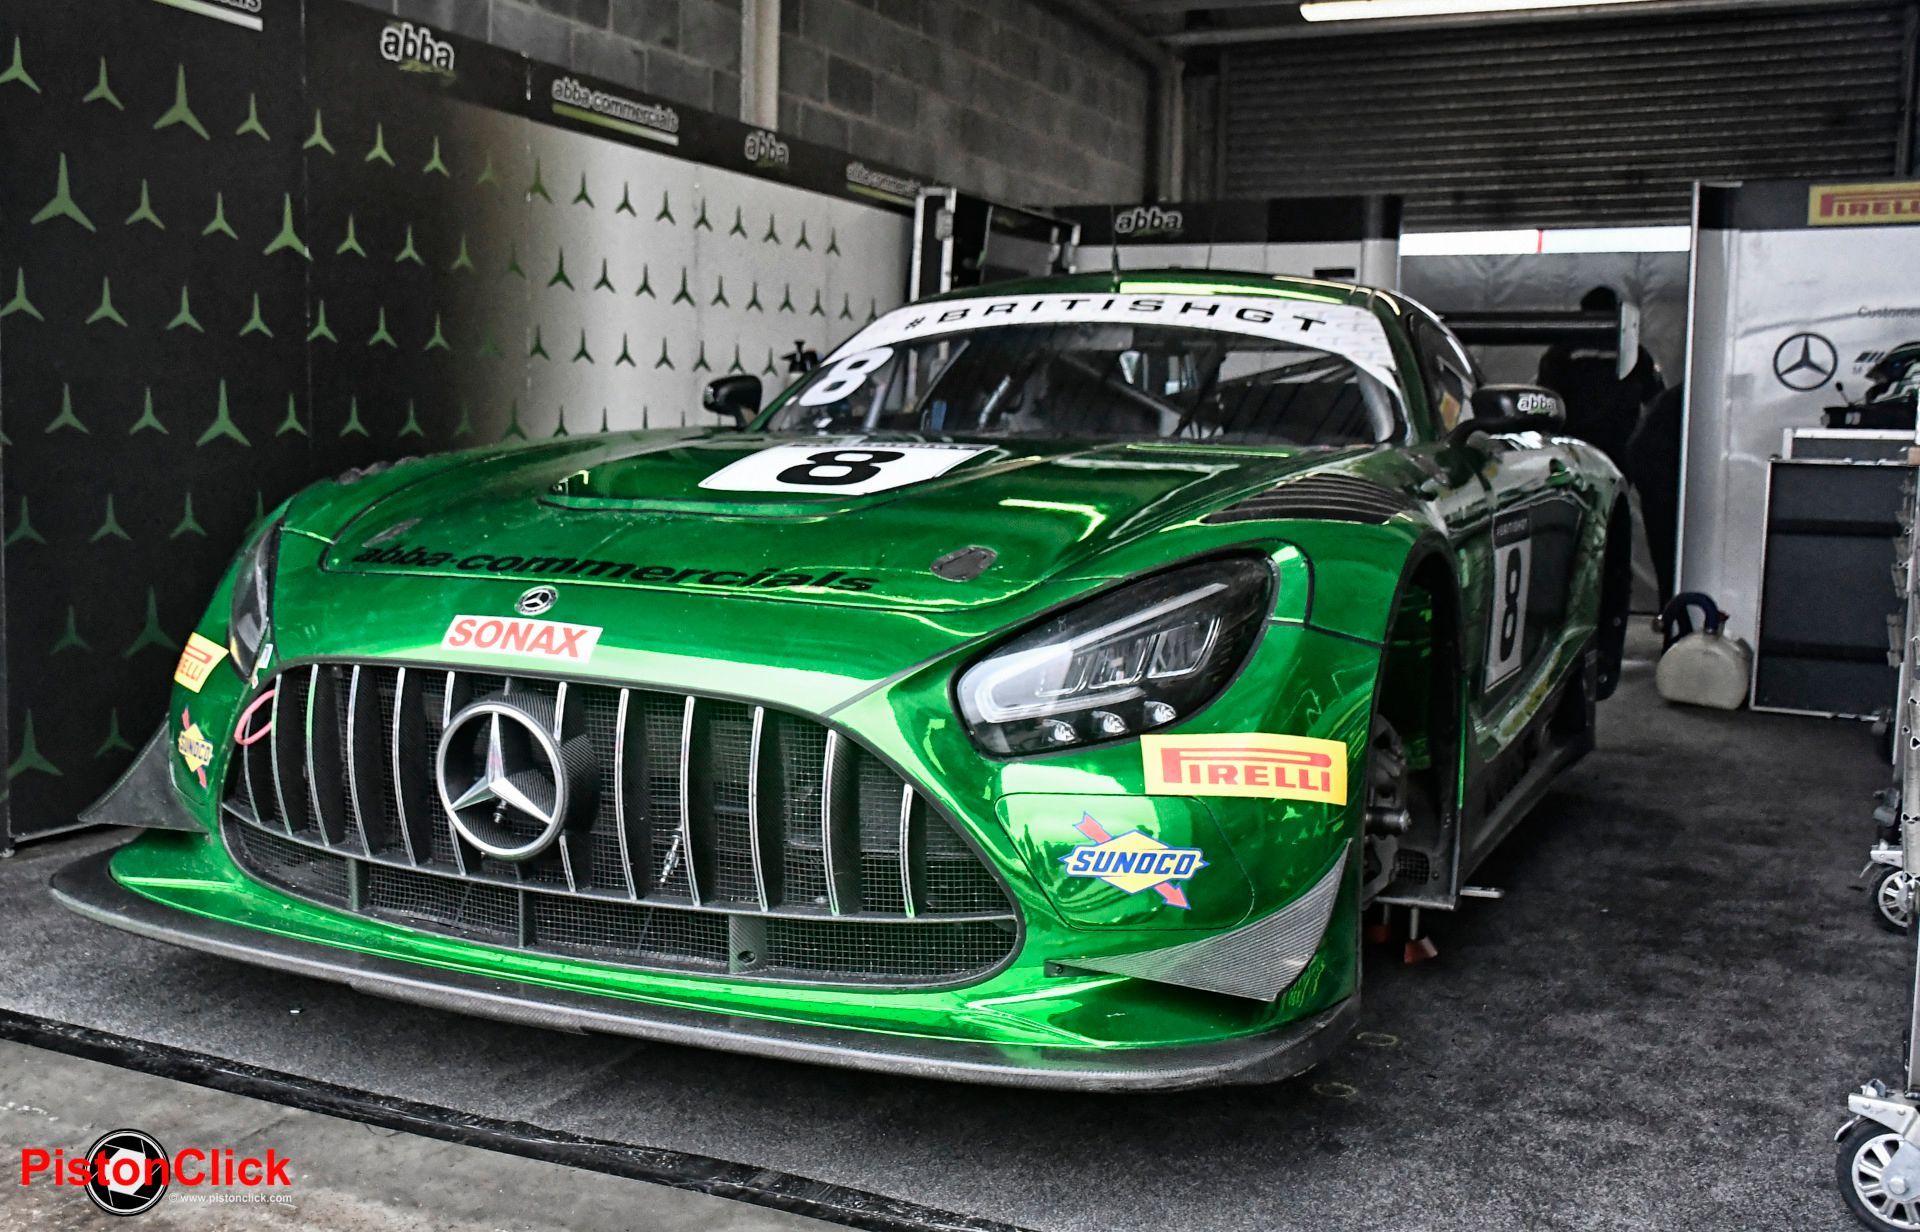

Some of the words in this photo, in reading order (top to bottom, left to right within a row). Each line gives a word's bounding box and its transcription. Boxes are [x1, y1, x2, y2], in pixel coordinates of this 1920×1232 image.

[380, 21, 454, 70] abba
[744, 130, 789, 165] abba
[1115, 206, 1183, 233] abba
[800, 347, 893, 405] 8
[1517, 393, 1556, 413] abba
[776, 450, 906, 486] 8
[1499, 547, 1522, 662] 8
[449, 619, 588, 658] SONAX
[1161, 747, 1332, 793] PIRELLI
[1072, 850, 1196, 876] SUNOCO
